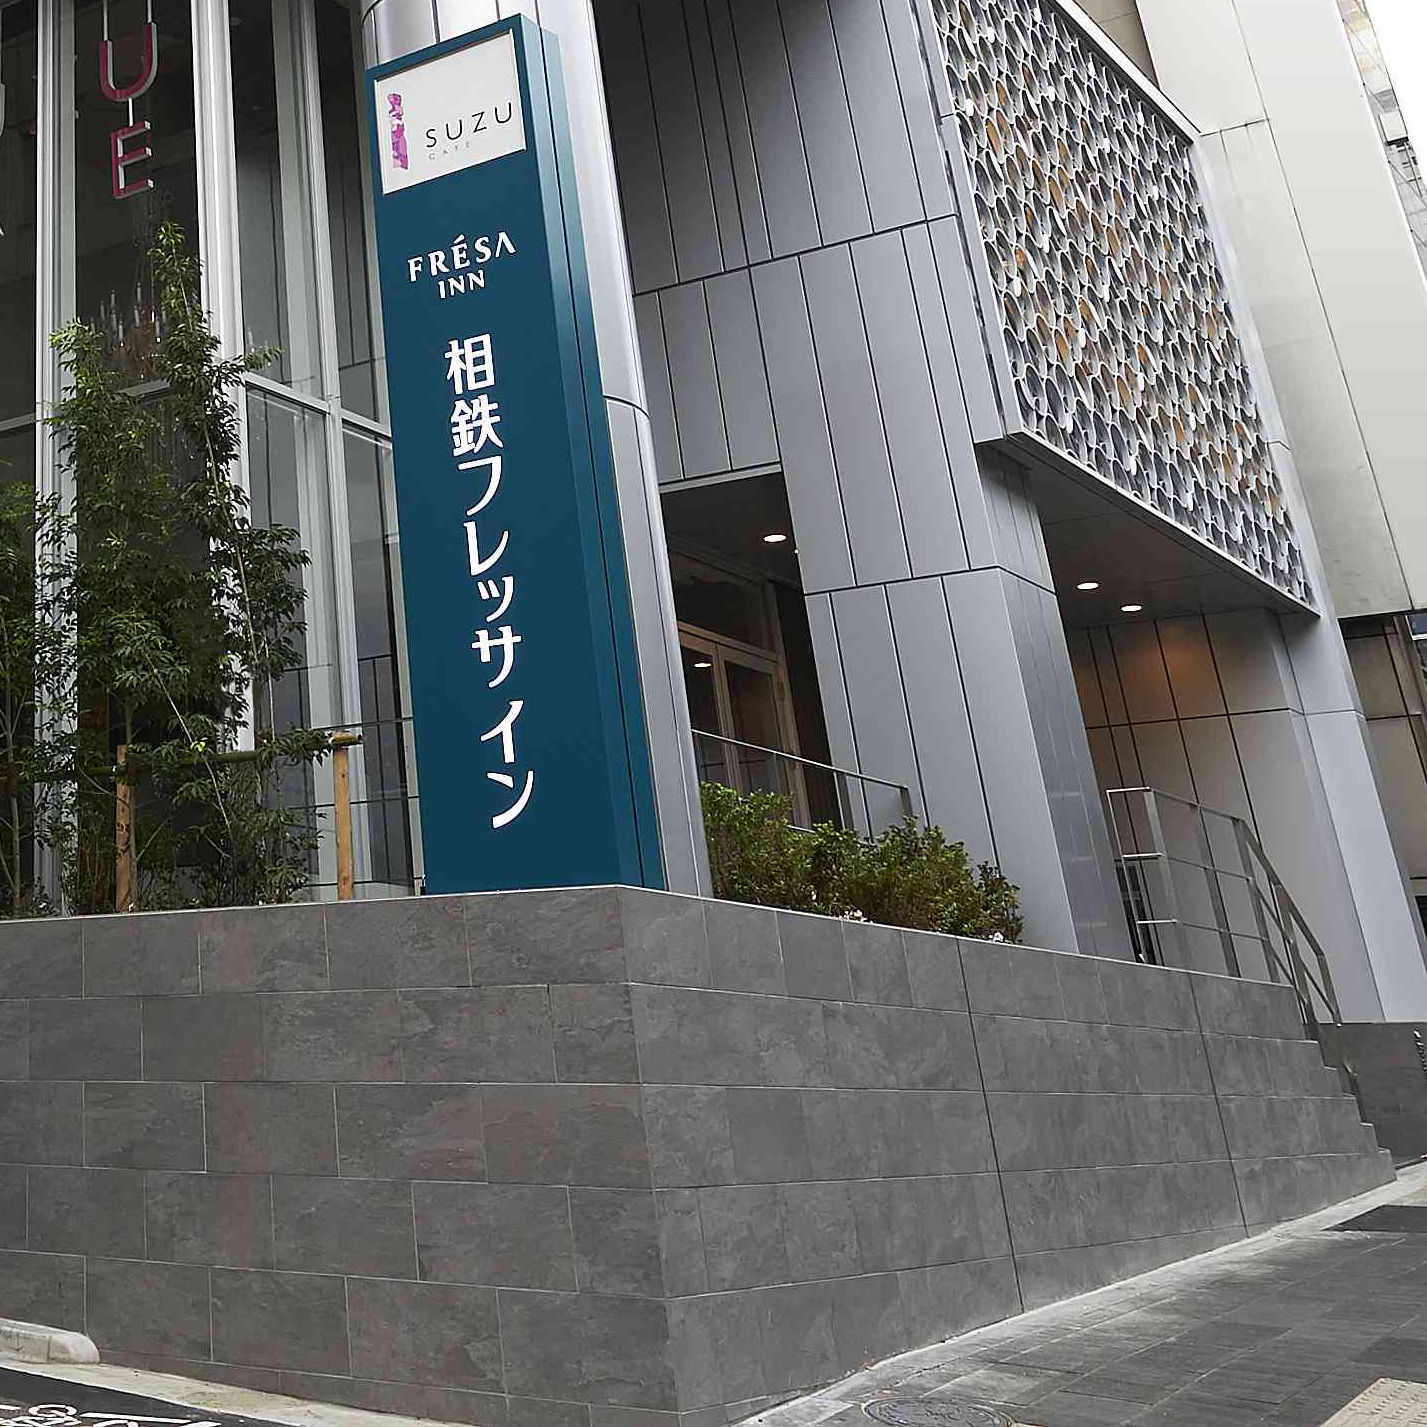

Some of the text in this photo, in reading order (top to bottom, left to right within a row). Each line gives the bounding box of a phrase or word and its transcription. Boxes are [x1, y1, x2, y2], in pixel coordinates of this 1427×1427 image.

[425, 102, 513, 148] SUZU
[407, 231, 517, 283] FRÉSA
[437, 269, 487, 300] INN
[444, 332, 535, 830] 相鉄フレッサイン
